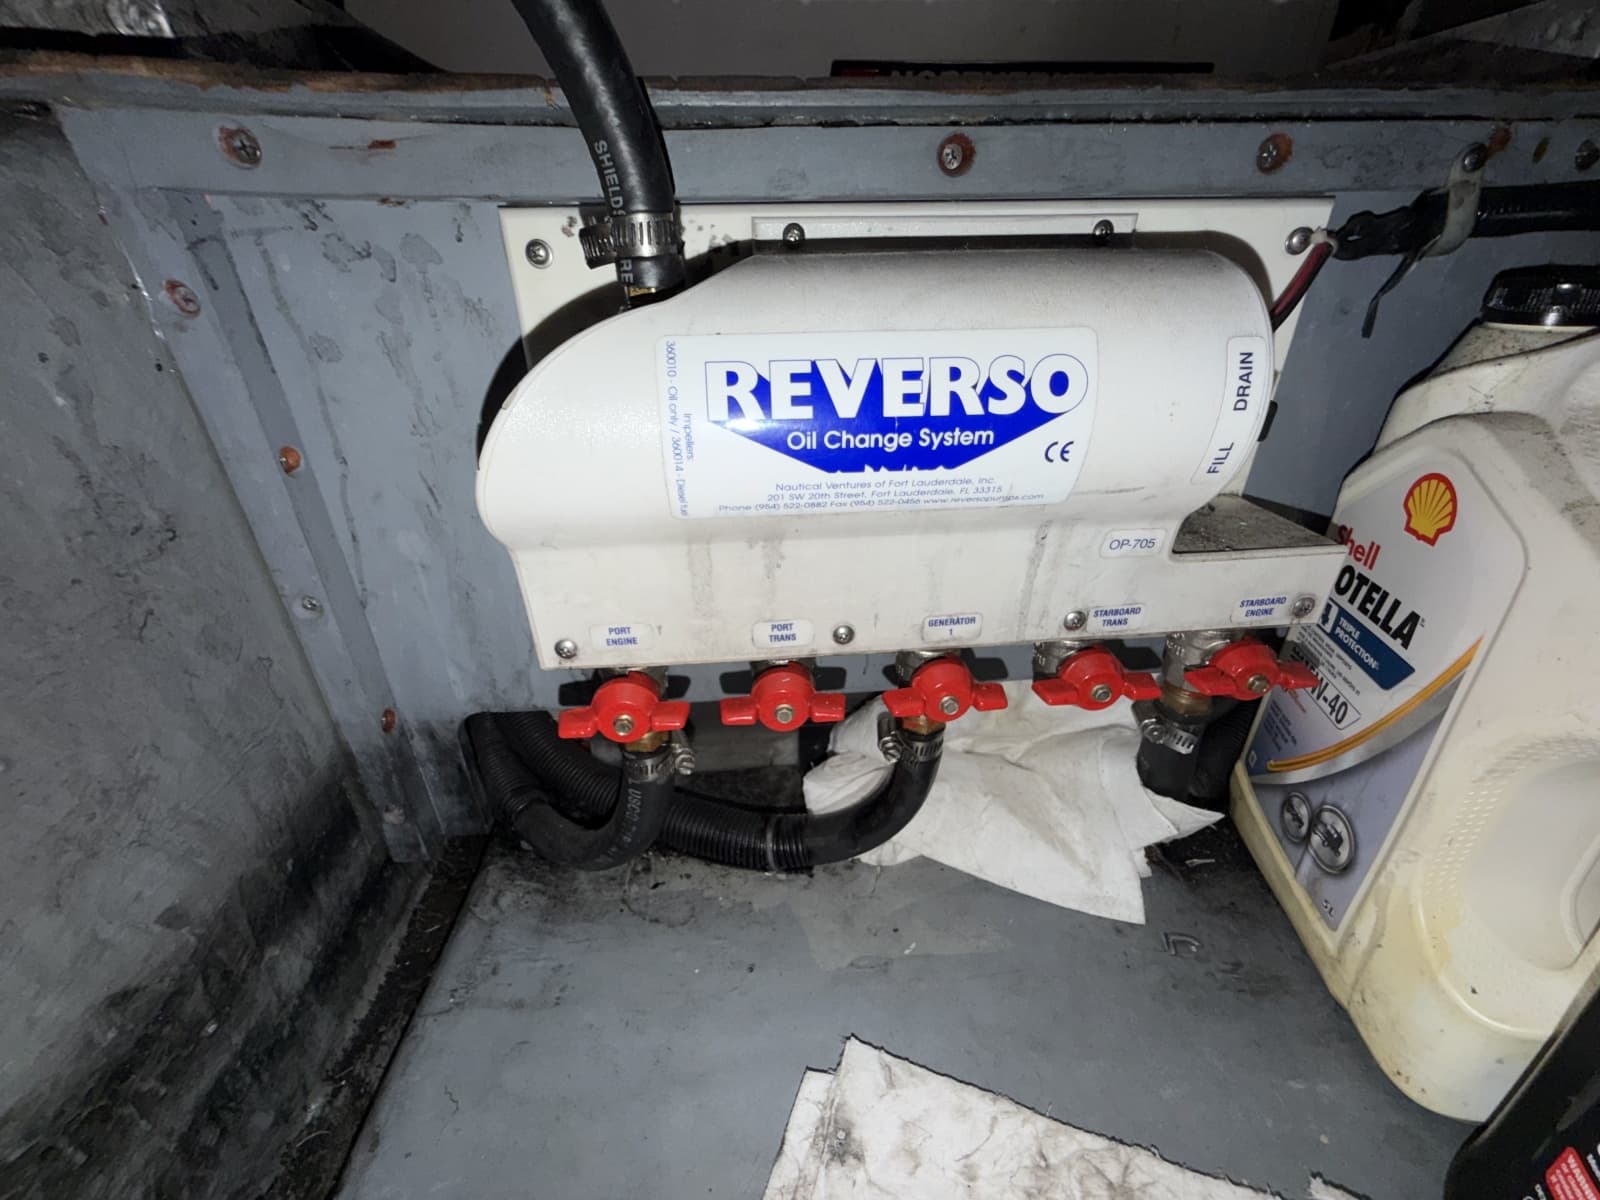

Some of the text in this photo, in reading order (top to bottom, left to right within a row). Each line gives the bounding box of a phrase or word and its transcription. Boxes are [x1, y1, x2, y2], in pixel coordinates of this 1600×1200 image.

[665, 340, 678, 378] 360010
[705, 354, 1089, 422] REVERSO
[1233, 352, 1254, 411] DRAIN
[667, 386, 679, 401] Oil
[668, 403, 680, 427] only
[786, 427, 994, 452] Oil Change System
[1206, 442, 1235, 474] FILL
[775, 482, 822, 492] Nautical
[825, 480, 872, 490] Ventures
[875, 480, 886, 488] of
[888, 478, 909, 487] Fort
[767, 493, 785, 502] 201
[788, 493, 805, 501] SW
[808, 491, 831, 500] 20th
[871, 489, 891, 498] Fort
[959, 487, 969, 495] FL
[972, 486, 1003, 494] 33315
[718, 504, 752, 512] Phone
[830, 500, 848, 508] Fax
[1109, 537, 1157, 551] OP-705
[1336, 524, 1381, 571] Shell
[1239, 595, 1287, 608] STARBOARD
[1334, 564, 1421, 650] OTELLA
[1093, 606, 1142, 618] STARBOARD
[1245, 606, 1274, 617] ENGINE
[771, 622, 794, 632] PORT
[927, 616, 977, 628] GENERATOR
[1102, 617, 1128, 627] TRANS
[1339, 616, 1361, 640] TRIPLE
[608, 626, 632, 636] PORT
[768, 632, 797, 643] TRANS
[606, 637, 638, 646] ENGINE
